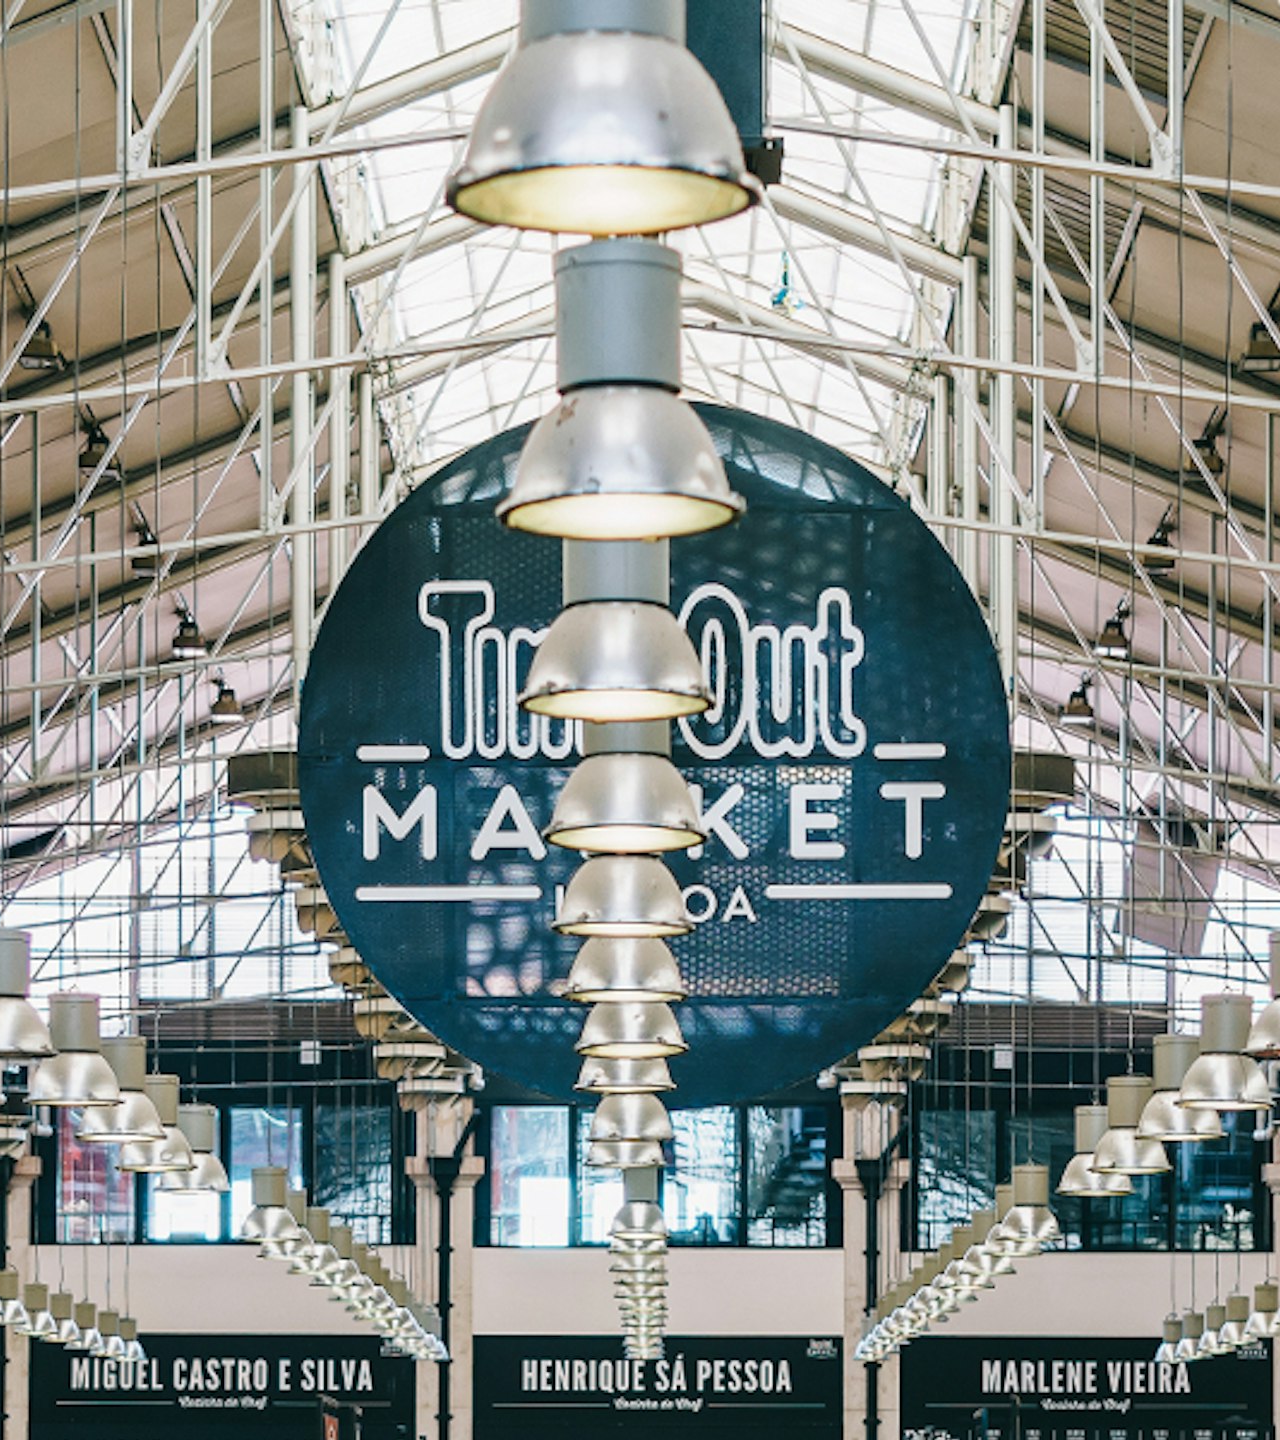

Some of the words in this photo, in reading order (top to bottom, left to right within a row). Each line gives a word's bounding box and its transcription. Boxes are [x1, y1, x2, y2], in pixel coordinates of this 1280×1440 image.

[675, 581, 867, 761] Out
[361, 782, 946, 862] MAKET
[70, 1357, 164, 1391] MIGUEL
[172, 1358, 268, 1391] CASTRO
[278, 1359, 291, 1391] E
[300, 1358, 374, 1392] SILVA
[521, 1359, 647, 1393] HENRIQUE
[655, 1354, 687, 1391] SÁ
[696, 1359, 792, 1392] PESSOA
[981, 1360, 1098, 1394] MARLENE
[1106, 1360, 1192, 1393] VIEIRA
